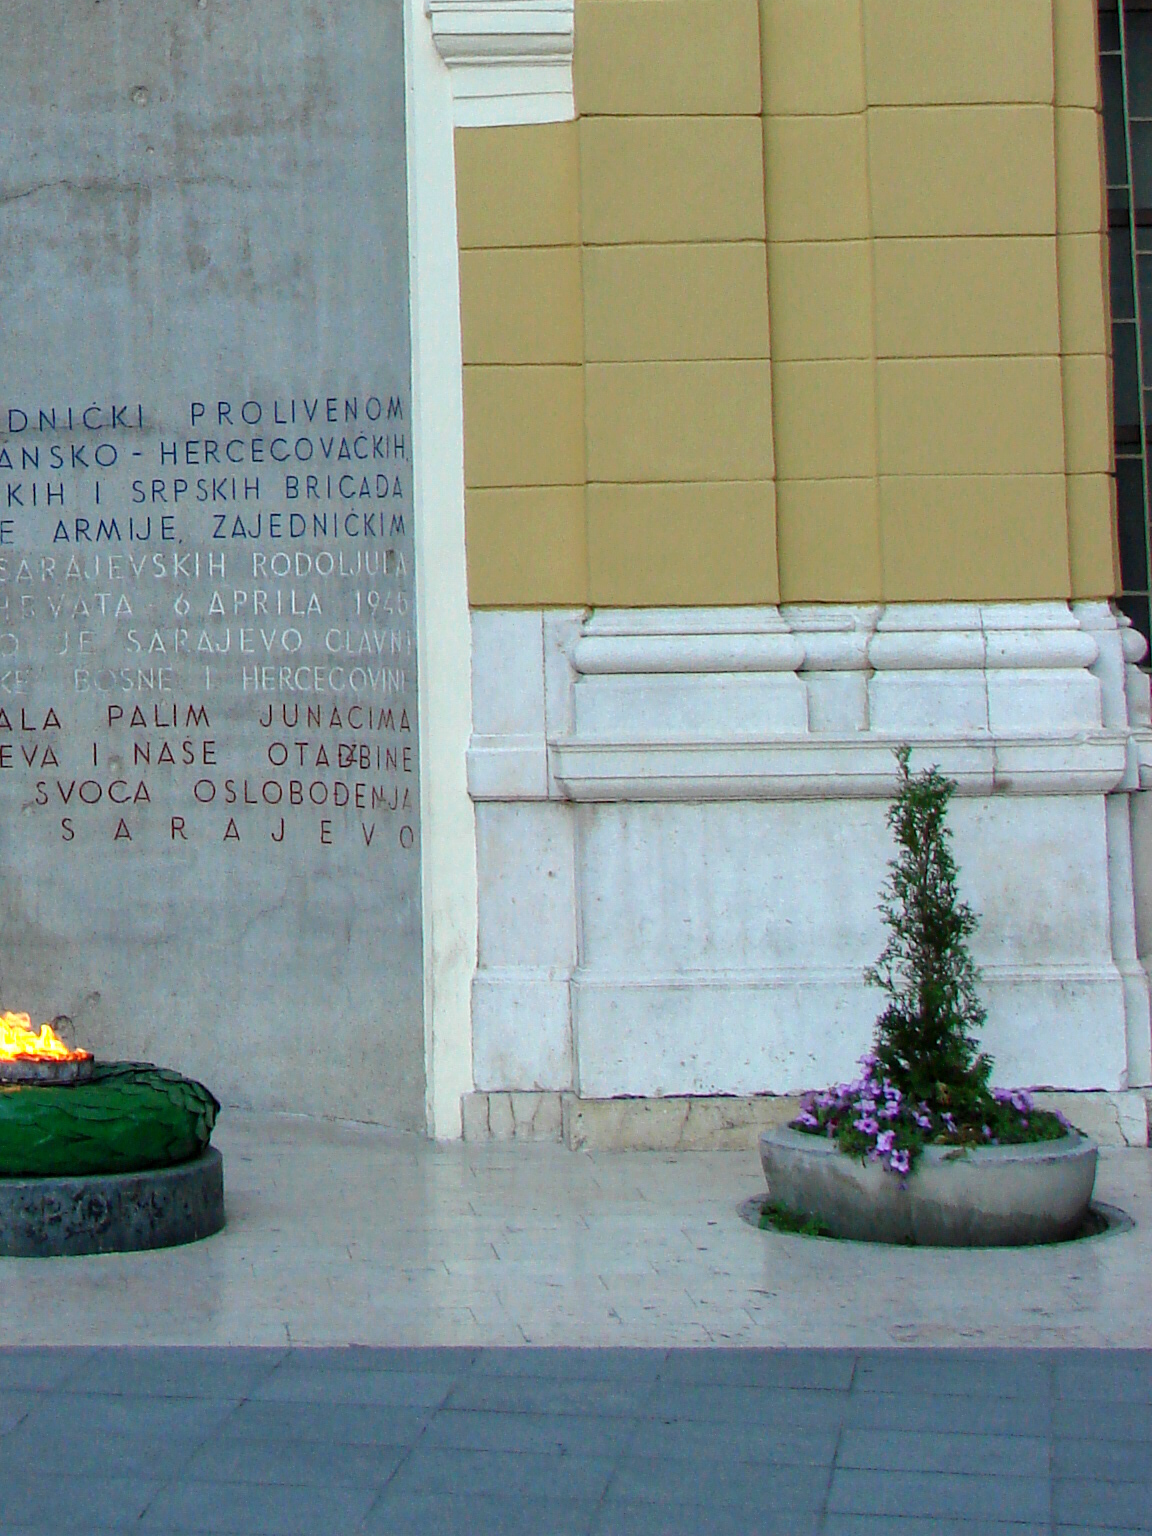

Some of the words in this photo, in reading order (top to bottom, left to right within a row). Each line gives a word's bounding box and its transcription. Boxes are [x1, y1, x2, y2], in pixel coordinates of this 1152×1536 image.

[190, 396, 404, 427] PROLIVENOM
[94, 480, 101, 505] I
[132, 476, 260, 504] SRPSKIH
[174, 592, 191, 616] 6
[208, 589, 323, 616] APRILA
[57, 630, 97, 656] JE
[126, 627, 303, 655] SARAJEVO
[74, 666, 173, 693] BOSNE
[204, 665, 211, 691] I
[107, 703, 211, 728] PALIM
[259, 703, 411, 733] JUNACIMA
[92, 742, 98, 766] I
